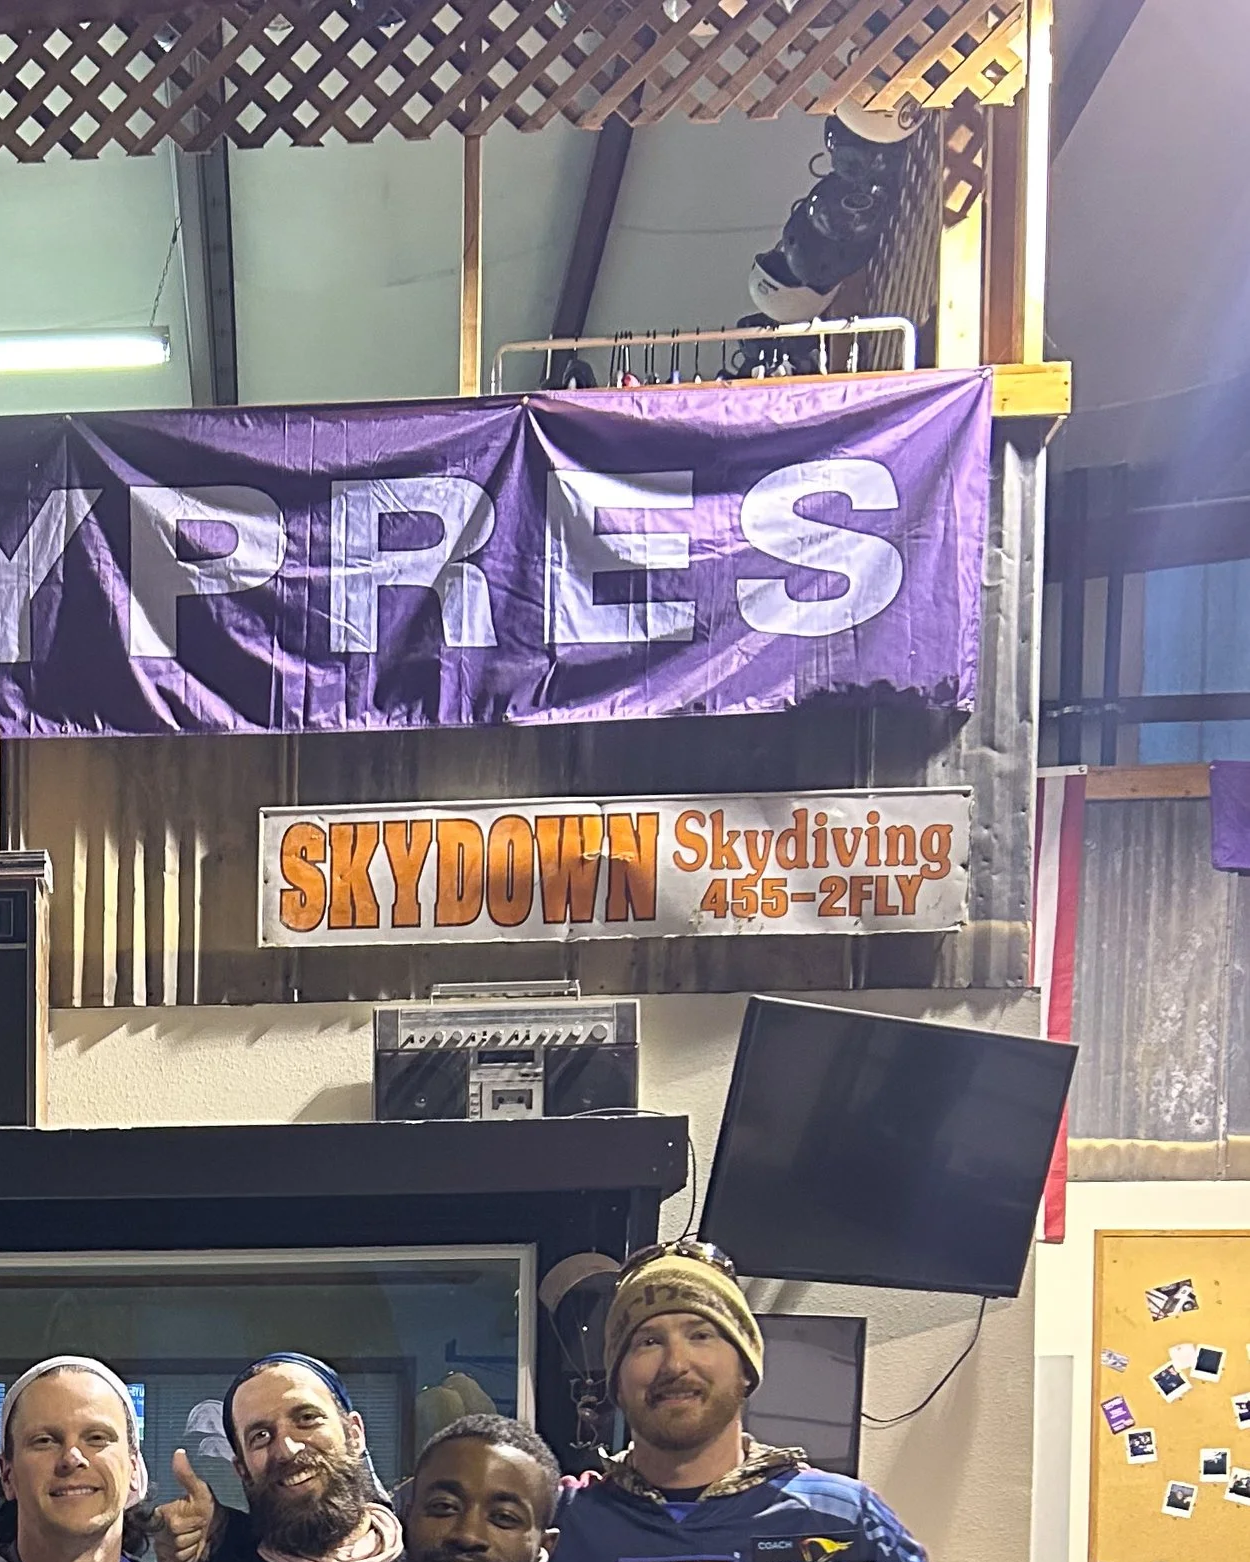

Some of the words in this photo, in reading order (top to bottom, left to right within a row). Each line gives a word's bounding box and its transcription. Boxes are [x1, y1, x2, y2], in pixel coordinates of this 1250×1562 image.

[279, 811, 660, 933] SKYDOWN
[673, 808, 954, 879] Skydiving
[701, 876, 924, 919] 455-2FLY
[757, 1541, 793, 1550] COACH
